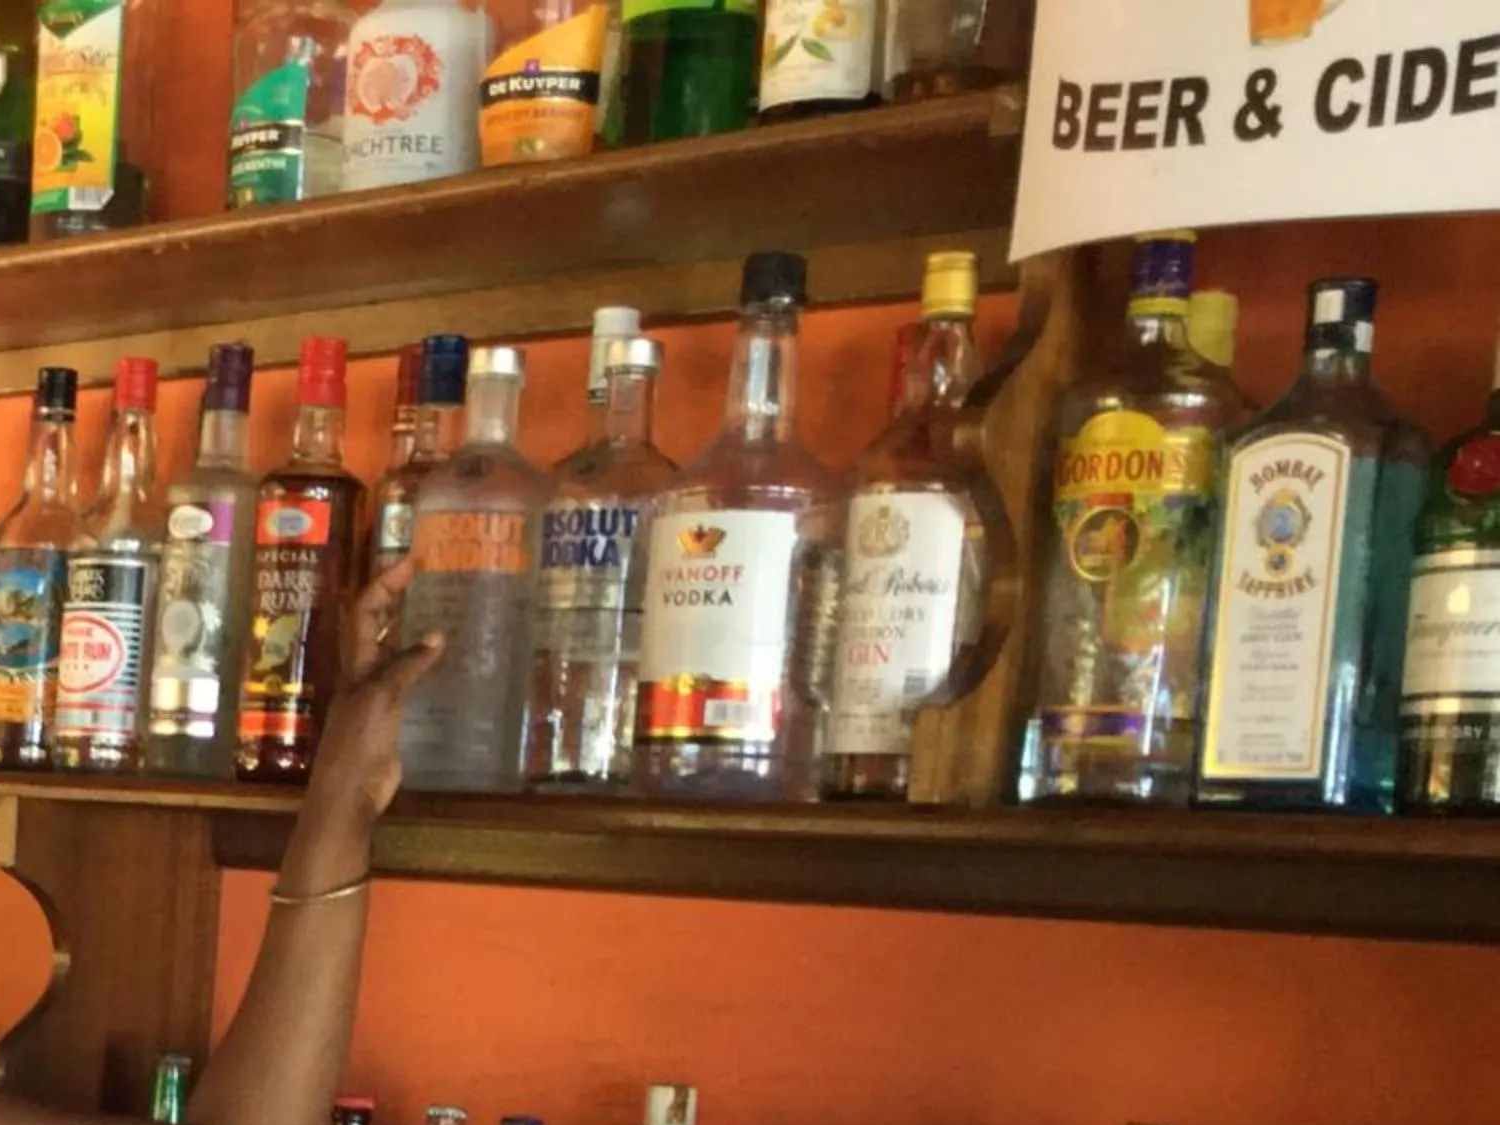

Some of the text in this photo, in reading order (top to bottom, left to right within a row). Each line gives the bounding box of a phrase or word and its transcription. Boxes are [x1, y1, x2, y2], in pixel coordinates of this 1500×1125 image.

[508, 76, 582, 92] KUYPER
[1052, 75, 1210, 152] BEER
[1233, 67, 1283, 142] &
[349, 133, 444, 158] ACHTREE
[1248, 459, 1326, 496] BOMBAY
[541, 508, 638, 538] BSOLUT
[662, 588, 733, 607] VODKA
[1237, 567, 1318, 600] SAPPHIRE
